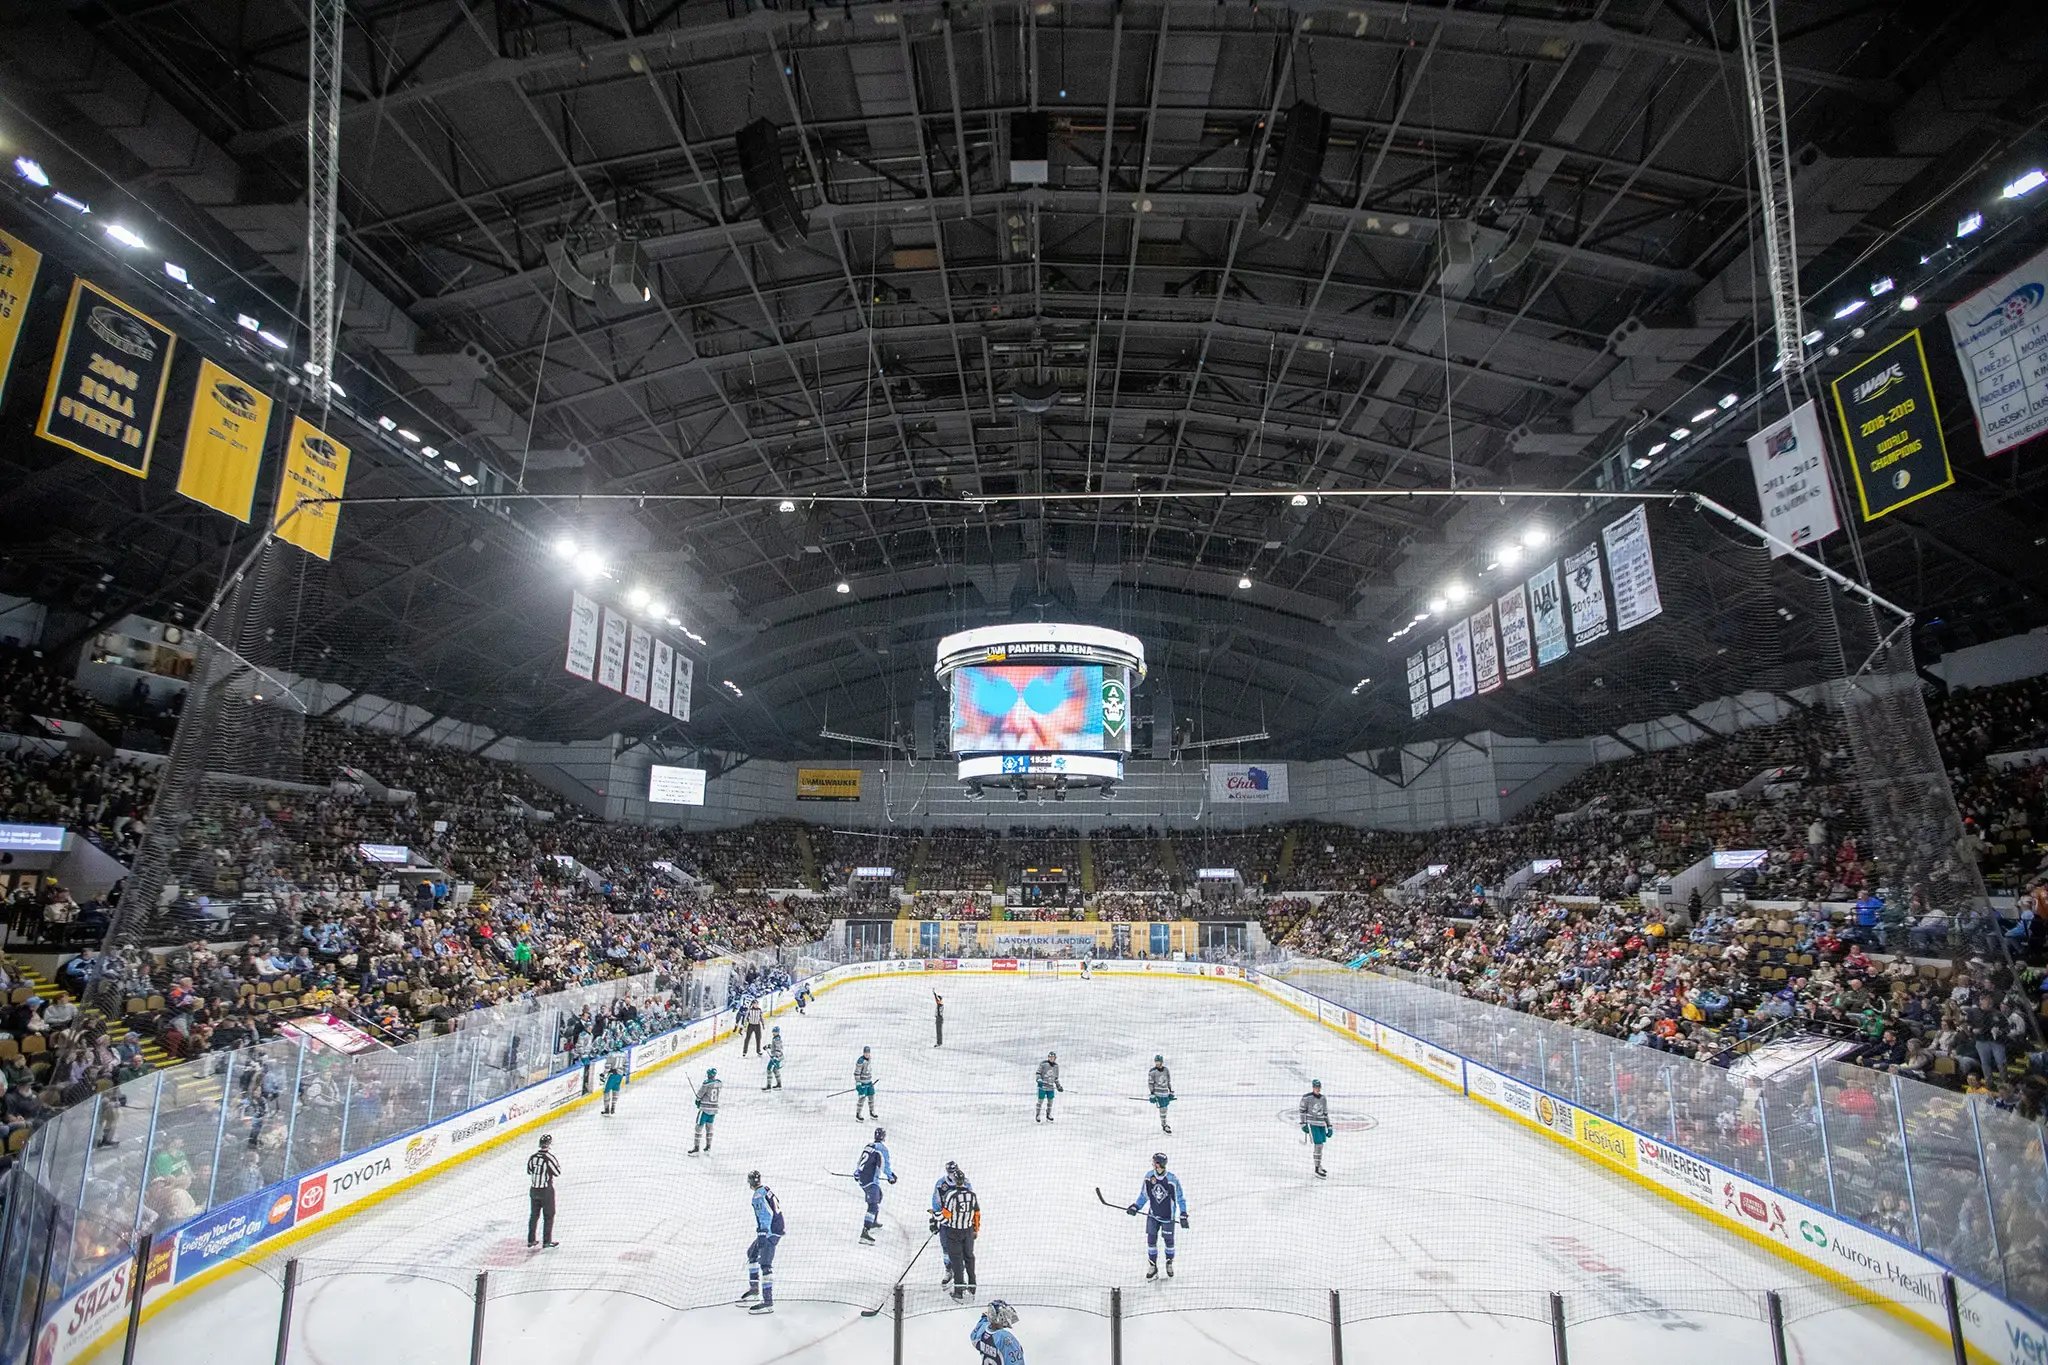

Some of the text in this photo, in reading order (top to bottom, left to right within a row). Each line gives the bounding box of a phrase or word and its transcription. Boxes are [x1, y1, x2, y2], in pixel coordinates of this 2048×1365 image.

[1956, 319, 2005, 348] MILWAUKEE
[2000, 317, 2026, 337] WAVE
[88, 352, 140, 391] 2005
[1992, 374, 2005, 387] 27
[78, 375, 135, 418] NCAA
[59, 396, 123, 439] SWEET
[1870, 439, 1923, 473] CHAMPIONS
[1008, 644, 1056, 653] PANTHER
[1059, 645, 1093, 655] ARENA
[1475, 637, 1494, 655] 2004
[998, 937, 1092, 945] LANDMARK LANDING
[1583, 1119, 1627, 1159] festival
[332, 1158, 392, 1194] TOYOTA
[1639, 1138, 1711, 1185] SUMMERFEST
[960, 1201, 970, 1212] 31
[180, 1215, 246, 1256] Energy You Can
[203, 1220, 261, 1258] Depend On
[1832, 1238, 1882, 1275] Aurora
[1887, 1261, 1938, 1304] Health
[68, 1264, 125, 1336] SAZ'S
